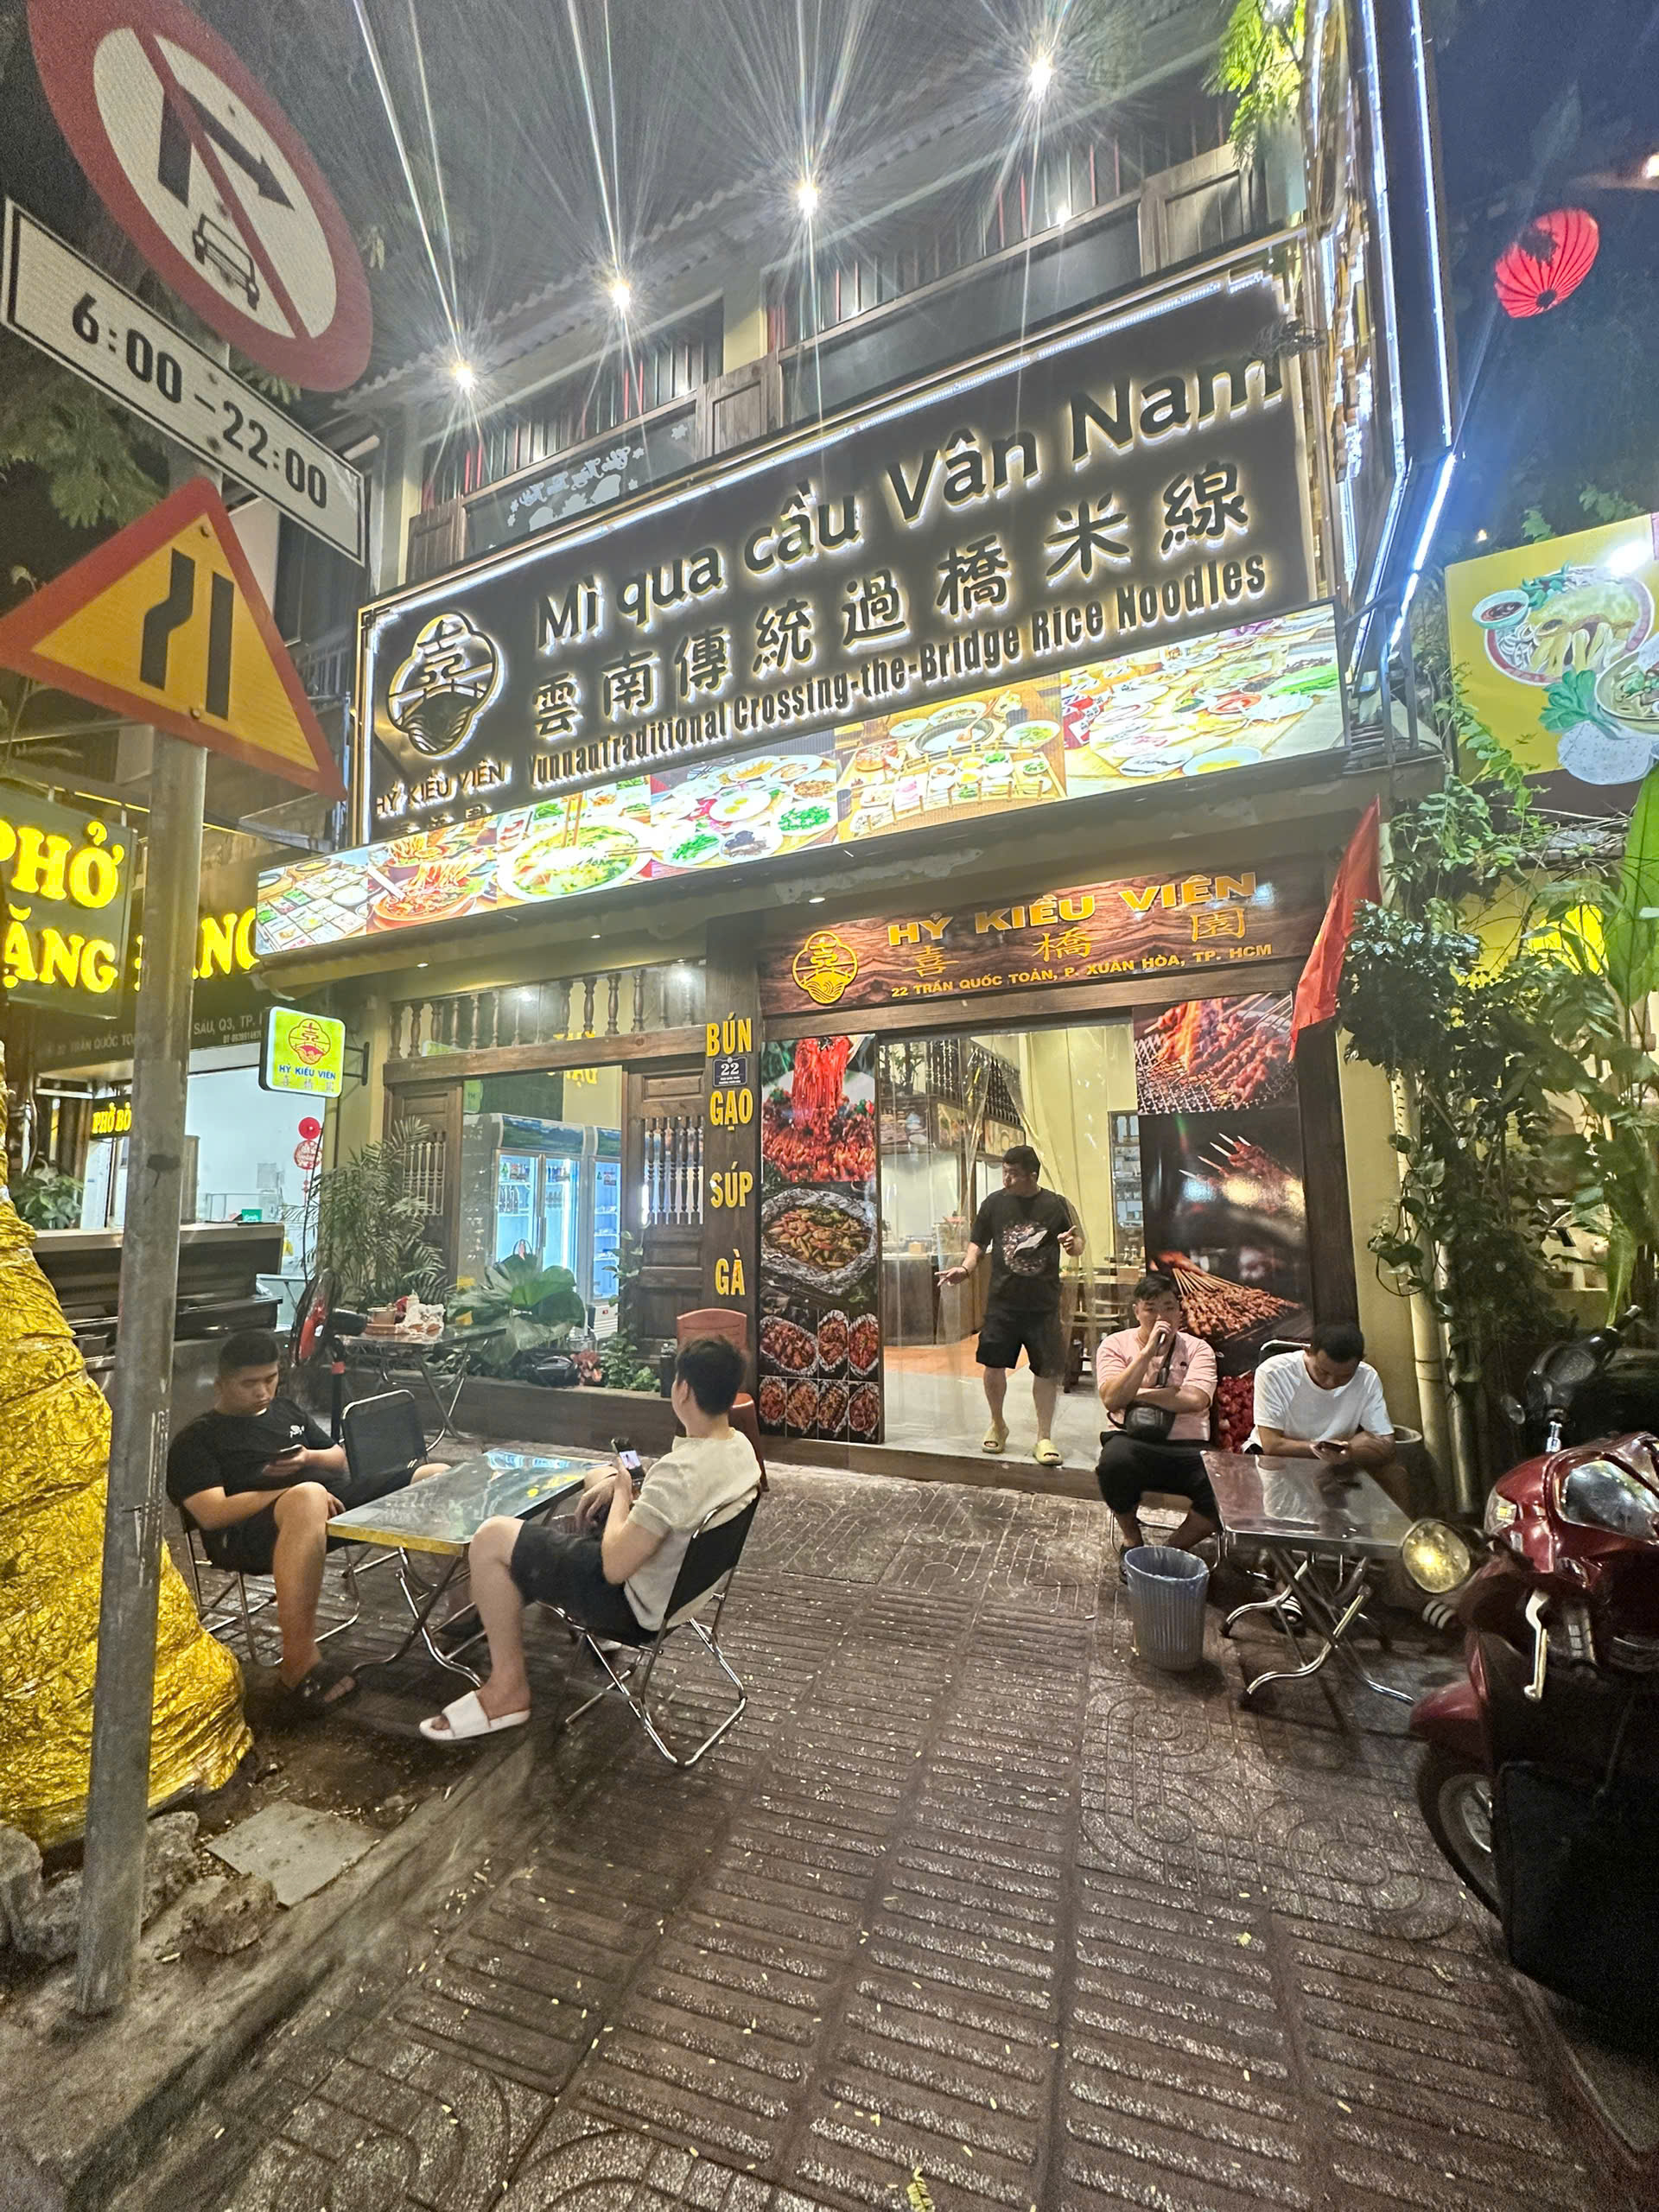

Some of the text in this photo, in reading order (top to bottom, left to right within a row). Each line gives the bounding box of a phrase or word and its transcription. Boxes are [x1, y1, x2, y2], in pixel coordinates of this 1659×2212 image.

[537, 353, 1283, 652] Mì qua cầu Vân Nam
[1032, 600, 1105, 654] Rice
[1116, 554, 1268, 632] Noodles
[457, 760, 510, 795] VIÊN
[887, 872, 1256, 947] HỶ KIỀU VIÊN
[891, 987, 909, 998] 22
[959, 973, 1002, 989] QUỐC
[1007, 968, 1058, 984] TOẢN,
[1064, 967, 1079, 977] P.
[1085, 959, 1135, 976] XUÂN
[1141, 953, 1185, 969] HÒA,
[1192, 950, 1221, 963] TP.
[1230, 944, 1272, 959] HCM
[219, 1017, 235, 1033] Q3,
[240, 1014, 256, 1028] TP.
[706, 1012, 753, 1057] BÚN
[721, 1062, 740, 1076] 22
[709, 1088, 753, 1131] GẠO
[709, 1161, 753, 1208] SÚP
[715, 1249, 746, 1296] GÀ
